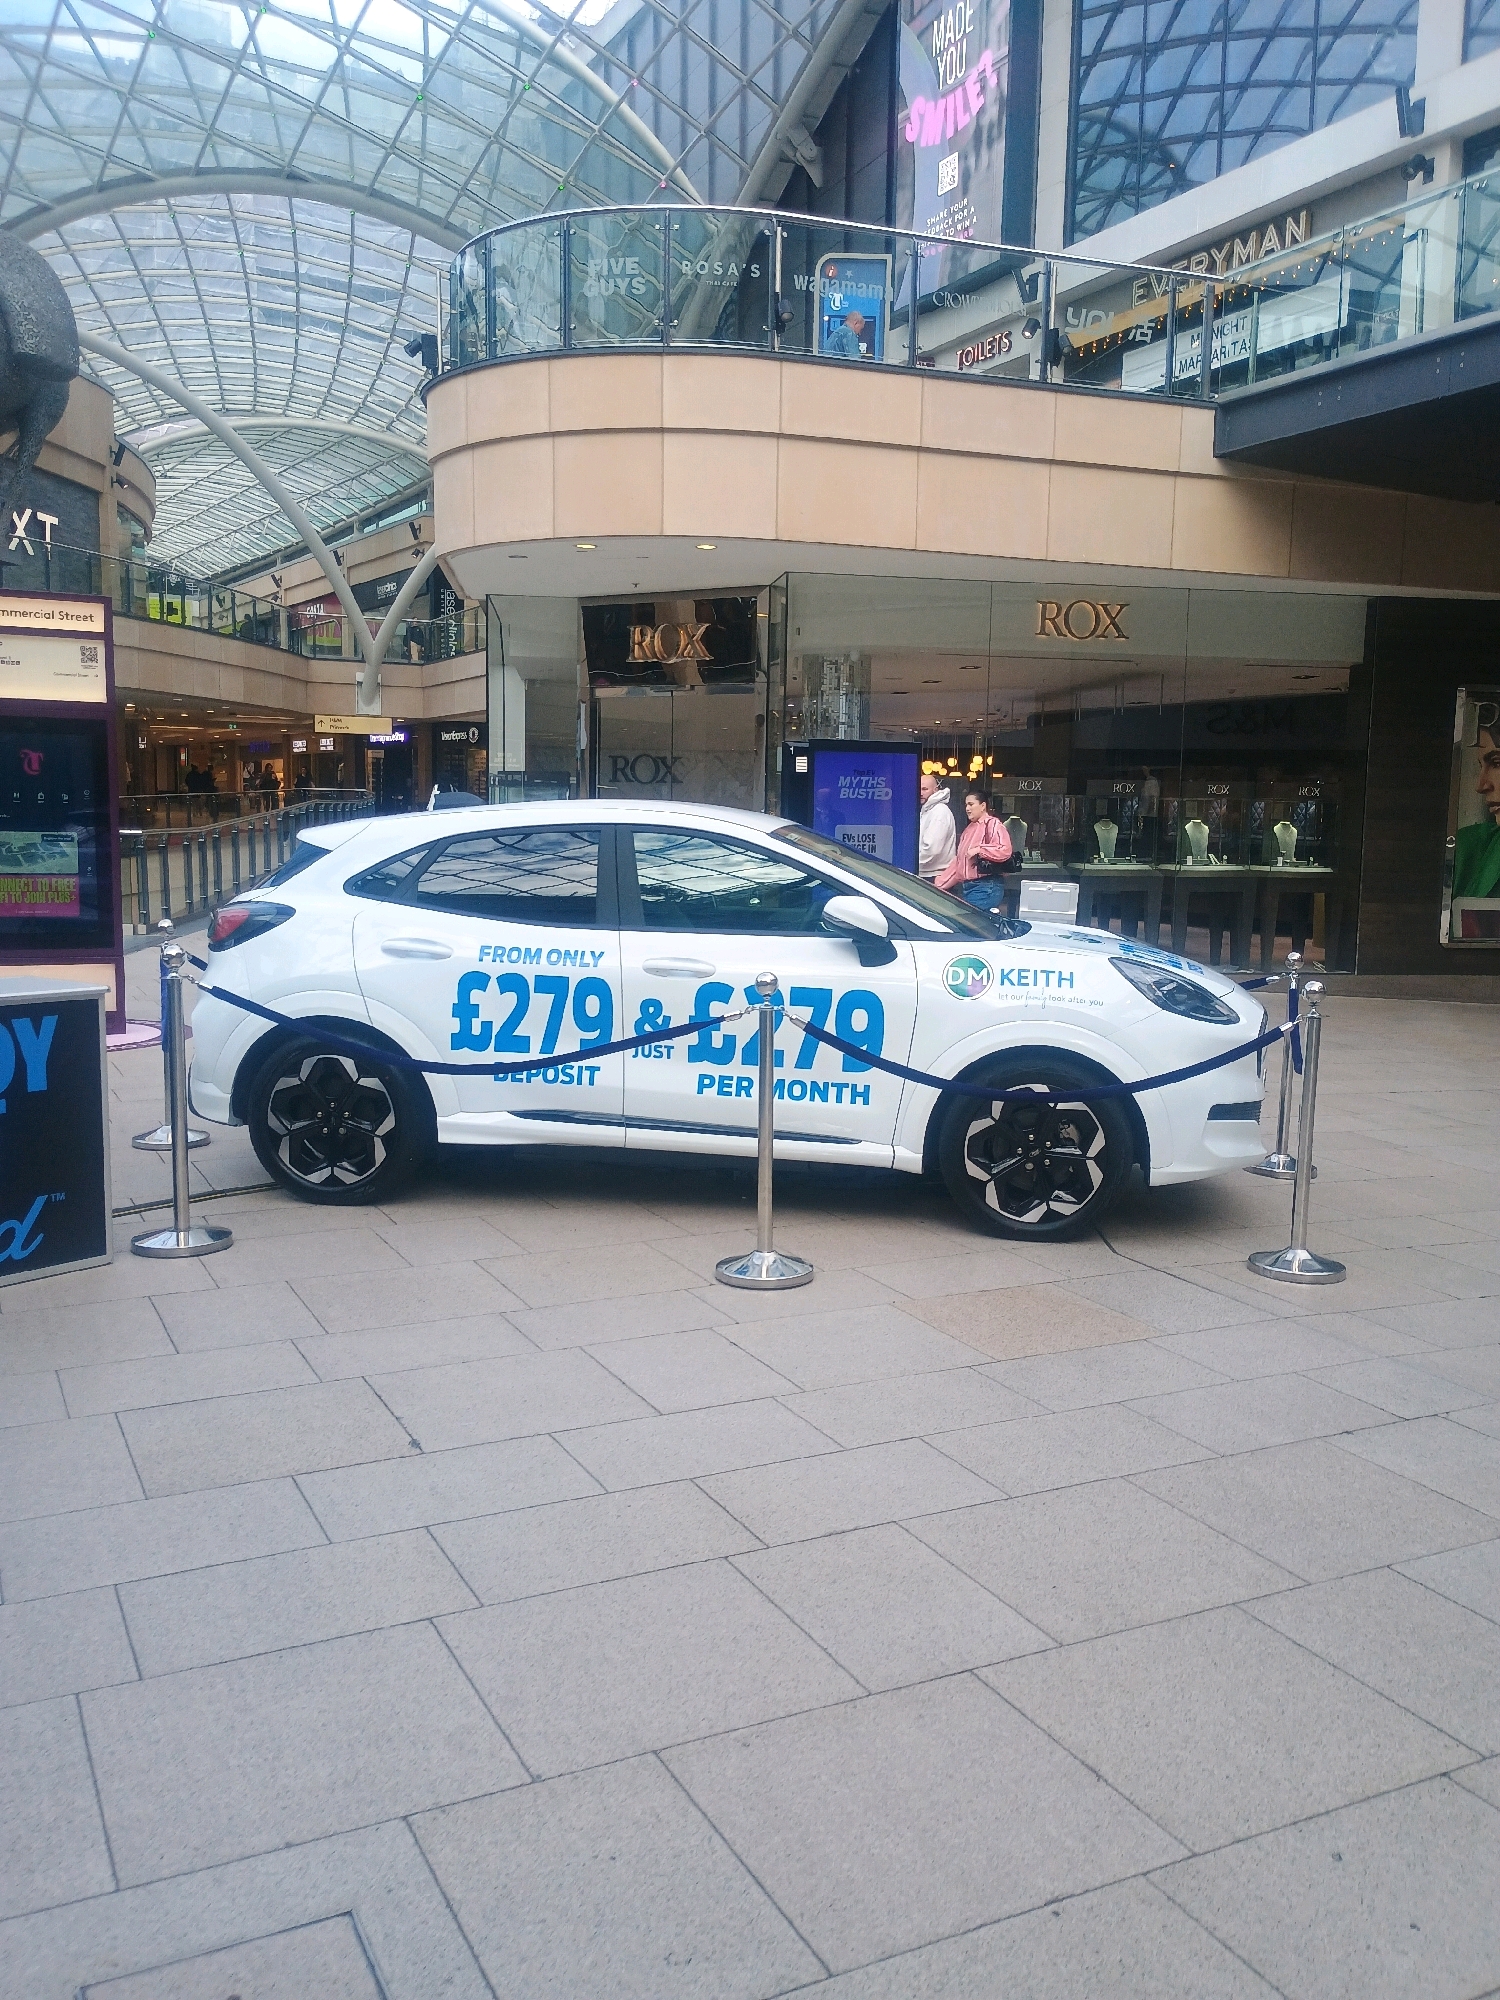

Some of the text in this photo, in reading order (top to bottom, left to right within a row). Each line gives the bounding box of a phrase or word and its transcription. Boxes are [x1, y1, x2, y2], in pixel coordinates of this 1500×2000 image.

[932, 0, 974, 57] MADE
[937, 38, 966, 90] YOU
[906, 49, 998, 148] SMILE?
[926, 198, 968, 227] SHARE YOUR
[955, 208, 968, 222] FOR
[970, 206, 975, 214] A
[945, 216, 977, 238] TO WIN A
[588, 256, 640, 277] FIVE
[682, 260, 761, 278] ROSA'S
[1132, 209, 1308, 310] EVERYMAN
[583, 278, 646, 297] GUYS
[1190, 315, 1248, 349] MNIGHT
[956, 331, 1013, 370] TOILETS
[1178, 338, 1253, 375] MARARITA
[58, 610, 94, 623] Street
[1035, 599, 1130, 639] ROX
[626, 623, 714, 664] ROX
[608, 753, 684, 784] ROX
[838, 776, 887, 788] MYTHS
[1018, 780, 1043, 791] ROX
[1113, 783, 1135, 794] ROX
[1207, 784, 1230, 795] ROX
[1298, 786, 1321, 797] ROX
[839, 788, 893, 800] BUSTED
[842, 833, 876, 843] EVs LOSE
[868, 844, 877, 853] IN
[36, 878, 50, 892] TO
[52, 878, 76, 892] FREE
[10, 891, 22, 904] TO
[478, 945, 606, 967] FROM ONLY
[947, 966, 1074, 989] DM KEITH
[1088, 998, 1104, 1007] you
[450, 970, 885, 1073] £279 & £279
[632, 1044, 675, 1060] JUST
[697, 1073, 754, 1098] PER
